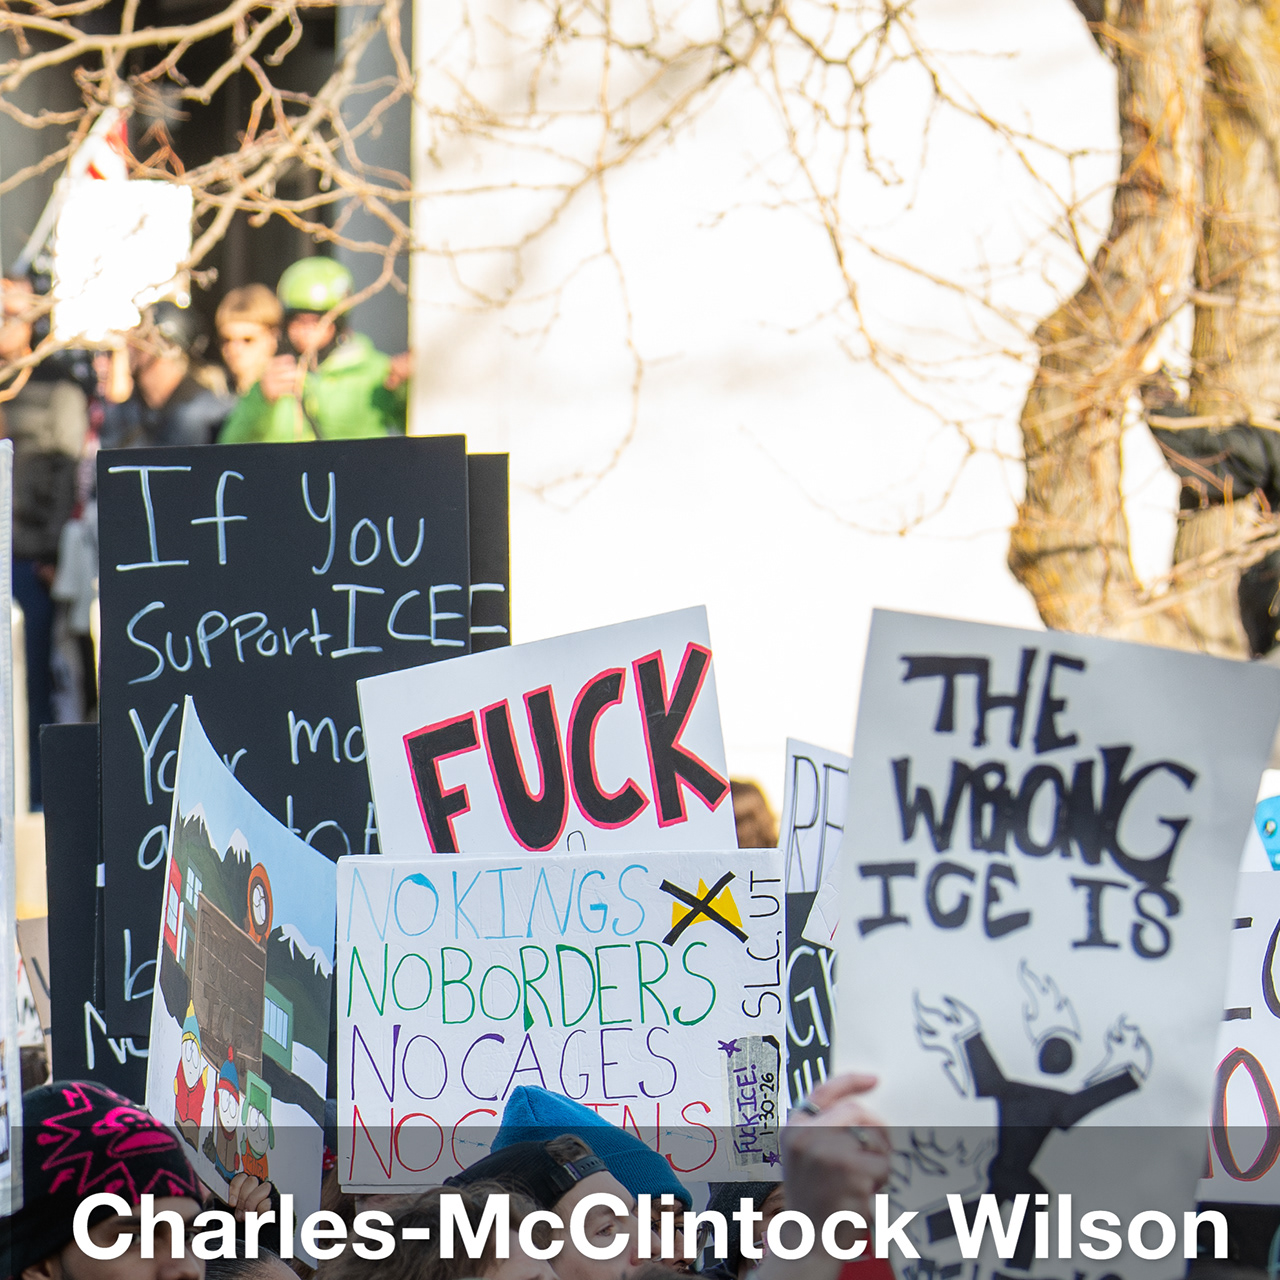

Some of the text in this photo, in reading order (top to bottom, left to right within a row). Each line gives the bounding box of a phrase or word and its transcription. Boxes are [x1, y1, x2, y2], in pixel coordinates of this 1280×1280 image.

[108, 465, 425, 575] If you
[899, 648, 1086, 753] THE
[403, 642, 731, 854] FUCK
[890, 744, 1199, 882] WRONG
[347, 864, 648, 942] NO KINGS
[750, 870, 781, 918] UT
[856, 861, 1180, 959] ICE IS
[348, 943, 433, 1018] NO
[441, 941, 717, 1031] BORDERS
[351, 1024, 678, 1102] NO CAGES
[759, 1072, 775, 1135] 1-30-26
[349, 1105, 443, 1179] NO
